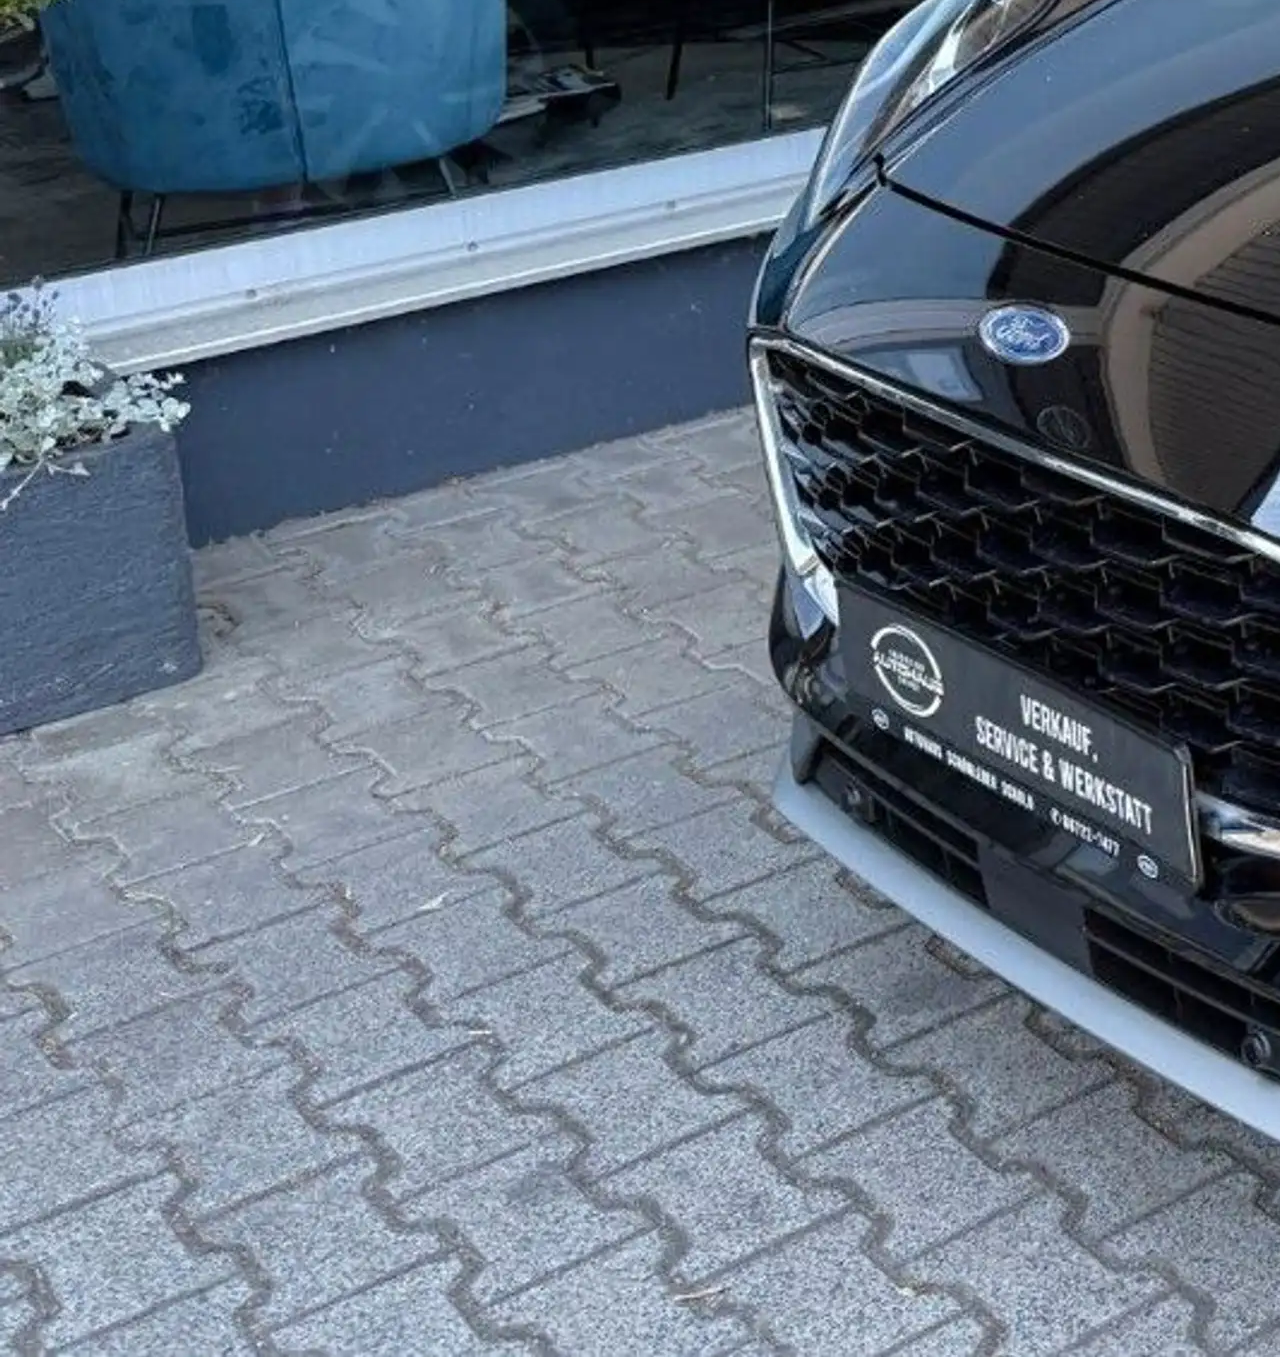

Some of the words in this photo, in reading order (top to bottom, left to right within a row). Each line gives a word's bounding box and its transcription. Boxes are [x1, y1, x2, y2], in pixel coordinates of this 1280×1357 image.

[975, 715, 1040, 774] SERVICE
[1042, 750, 1055, 782] &
[1059, 758, 1152, 835] WERKSTATT
[1020, 694, 1098, 763] VERKAUF,
